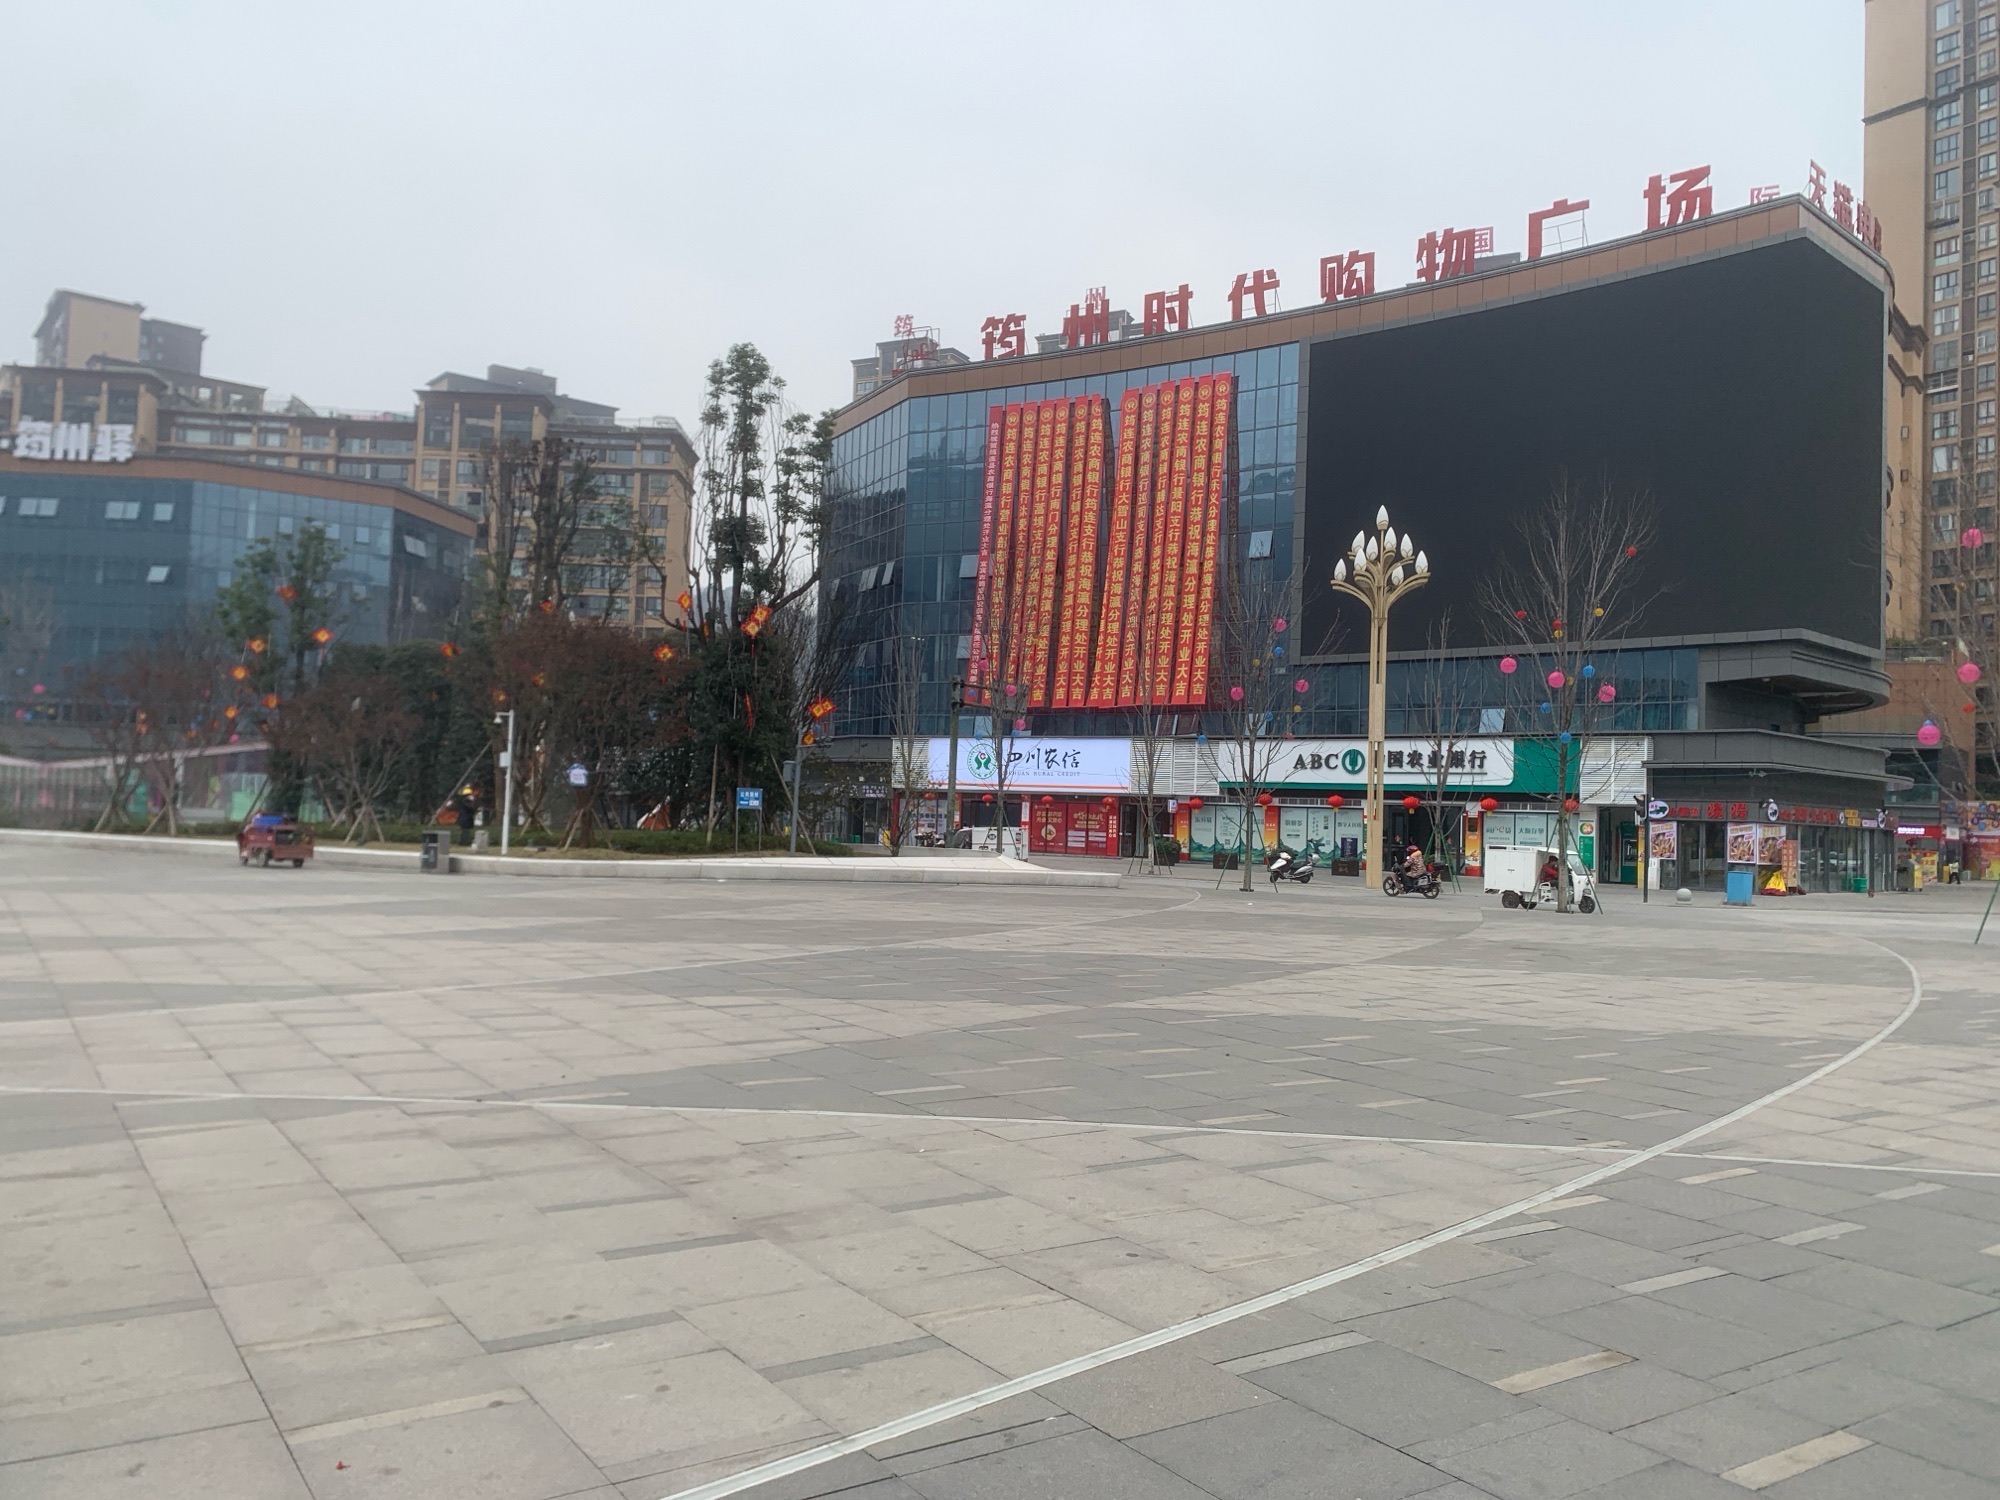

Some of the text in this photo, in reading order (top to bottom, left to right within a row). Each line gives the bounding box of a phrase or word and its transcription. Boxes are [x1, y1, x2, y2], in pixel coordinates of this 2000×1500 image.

[981, 164, 1713, 360] 筠州时代购物广场
[1007, 747, 1081, 770] 四川农信
[1293, 753, 1339, 770] ABC
[1384, 749, 1488, 769] 国农业银行
